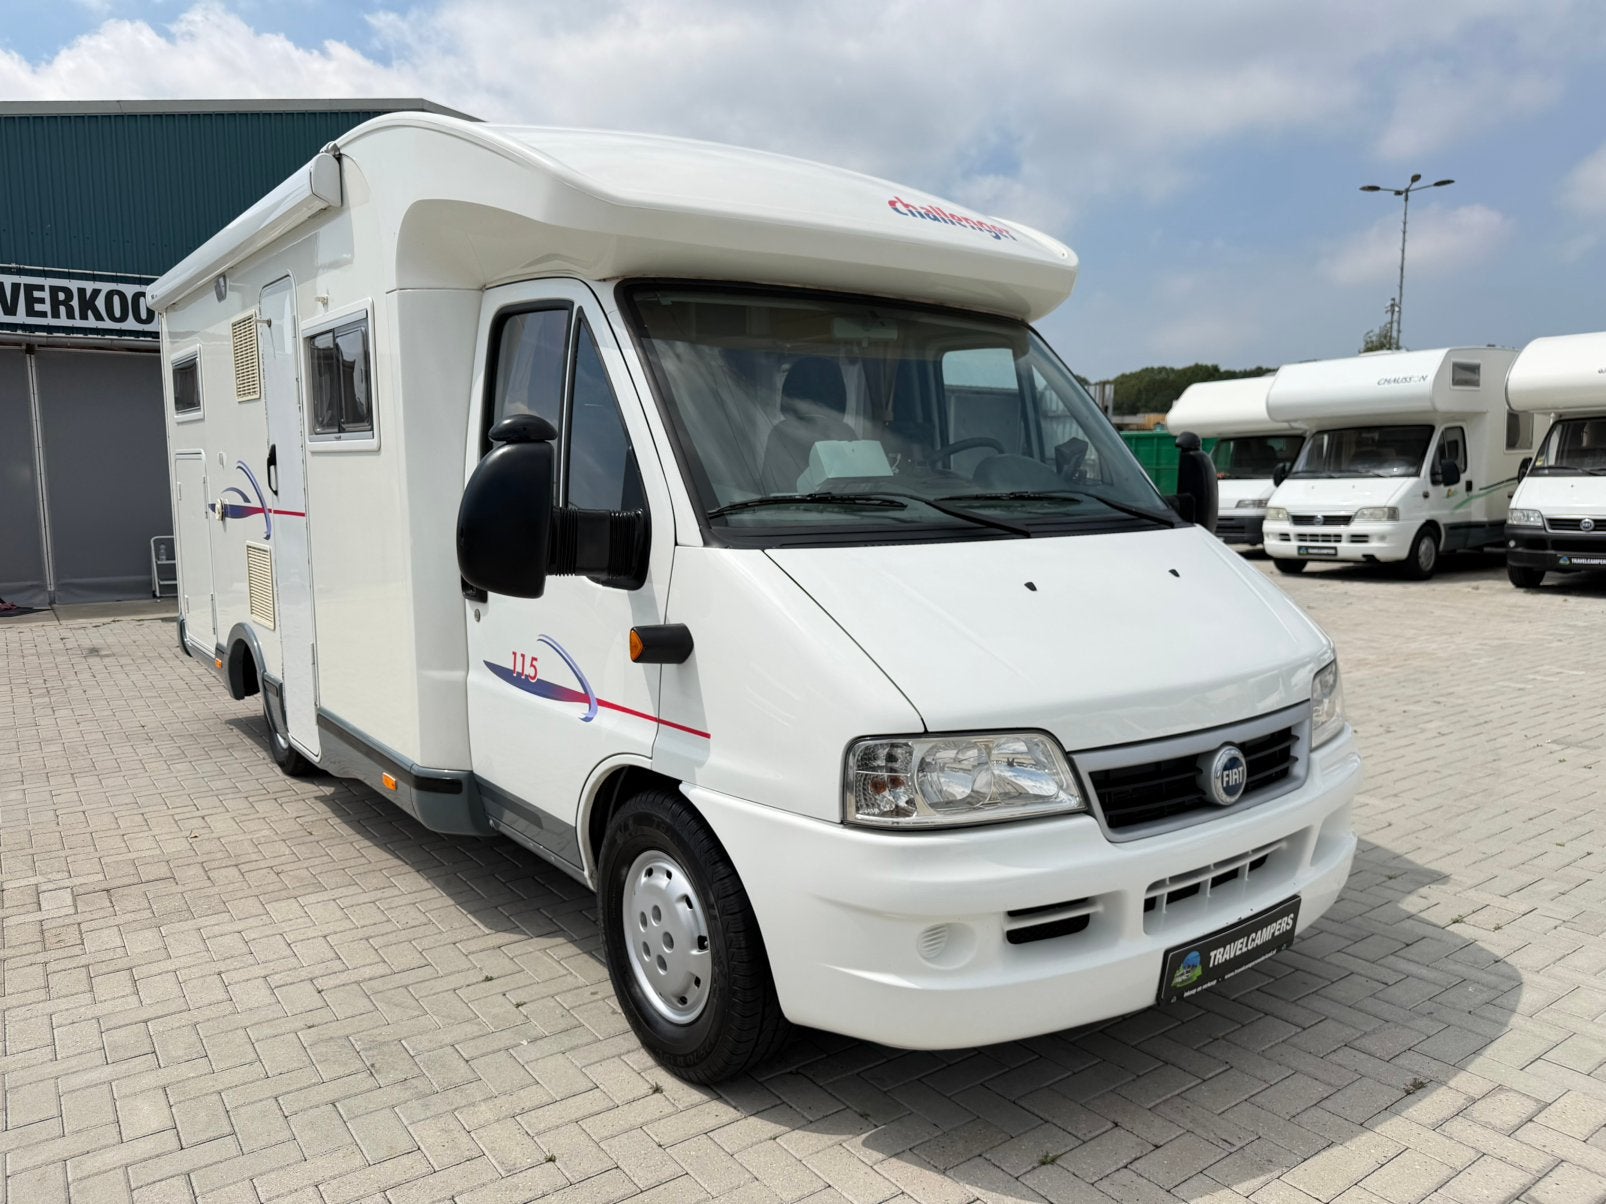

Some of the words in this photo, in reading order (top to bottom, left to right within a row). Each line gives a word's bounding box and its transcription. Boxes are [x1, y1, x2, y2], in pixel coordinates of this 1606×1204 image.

[1377, 374, 1428, 386] CHAUSSN
[512, 651, 538, 682] 115
[1222, 766, 1244, 788] FIAT
[1209, 912, 1294, 968] TRAVELCAMPERS
